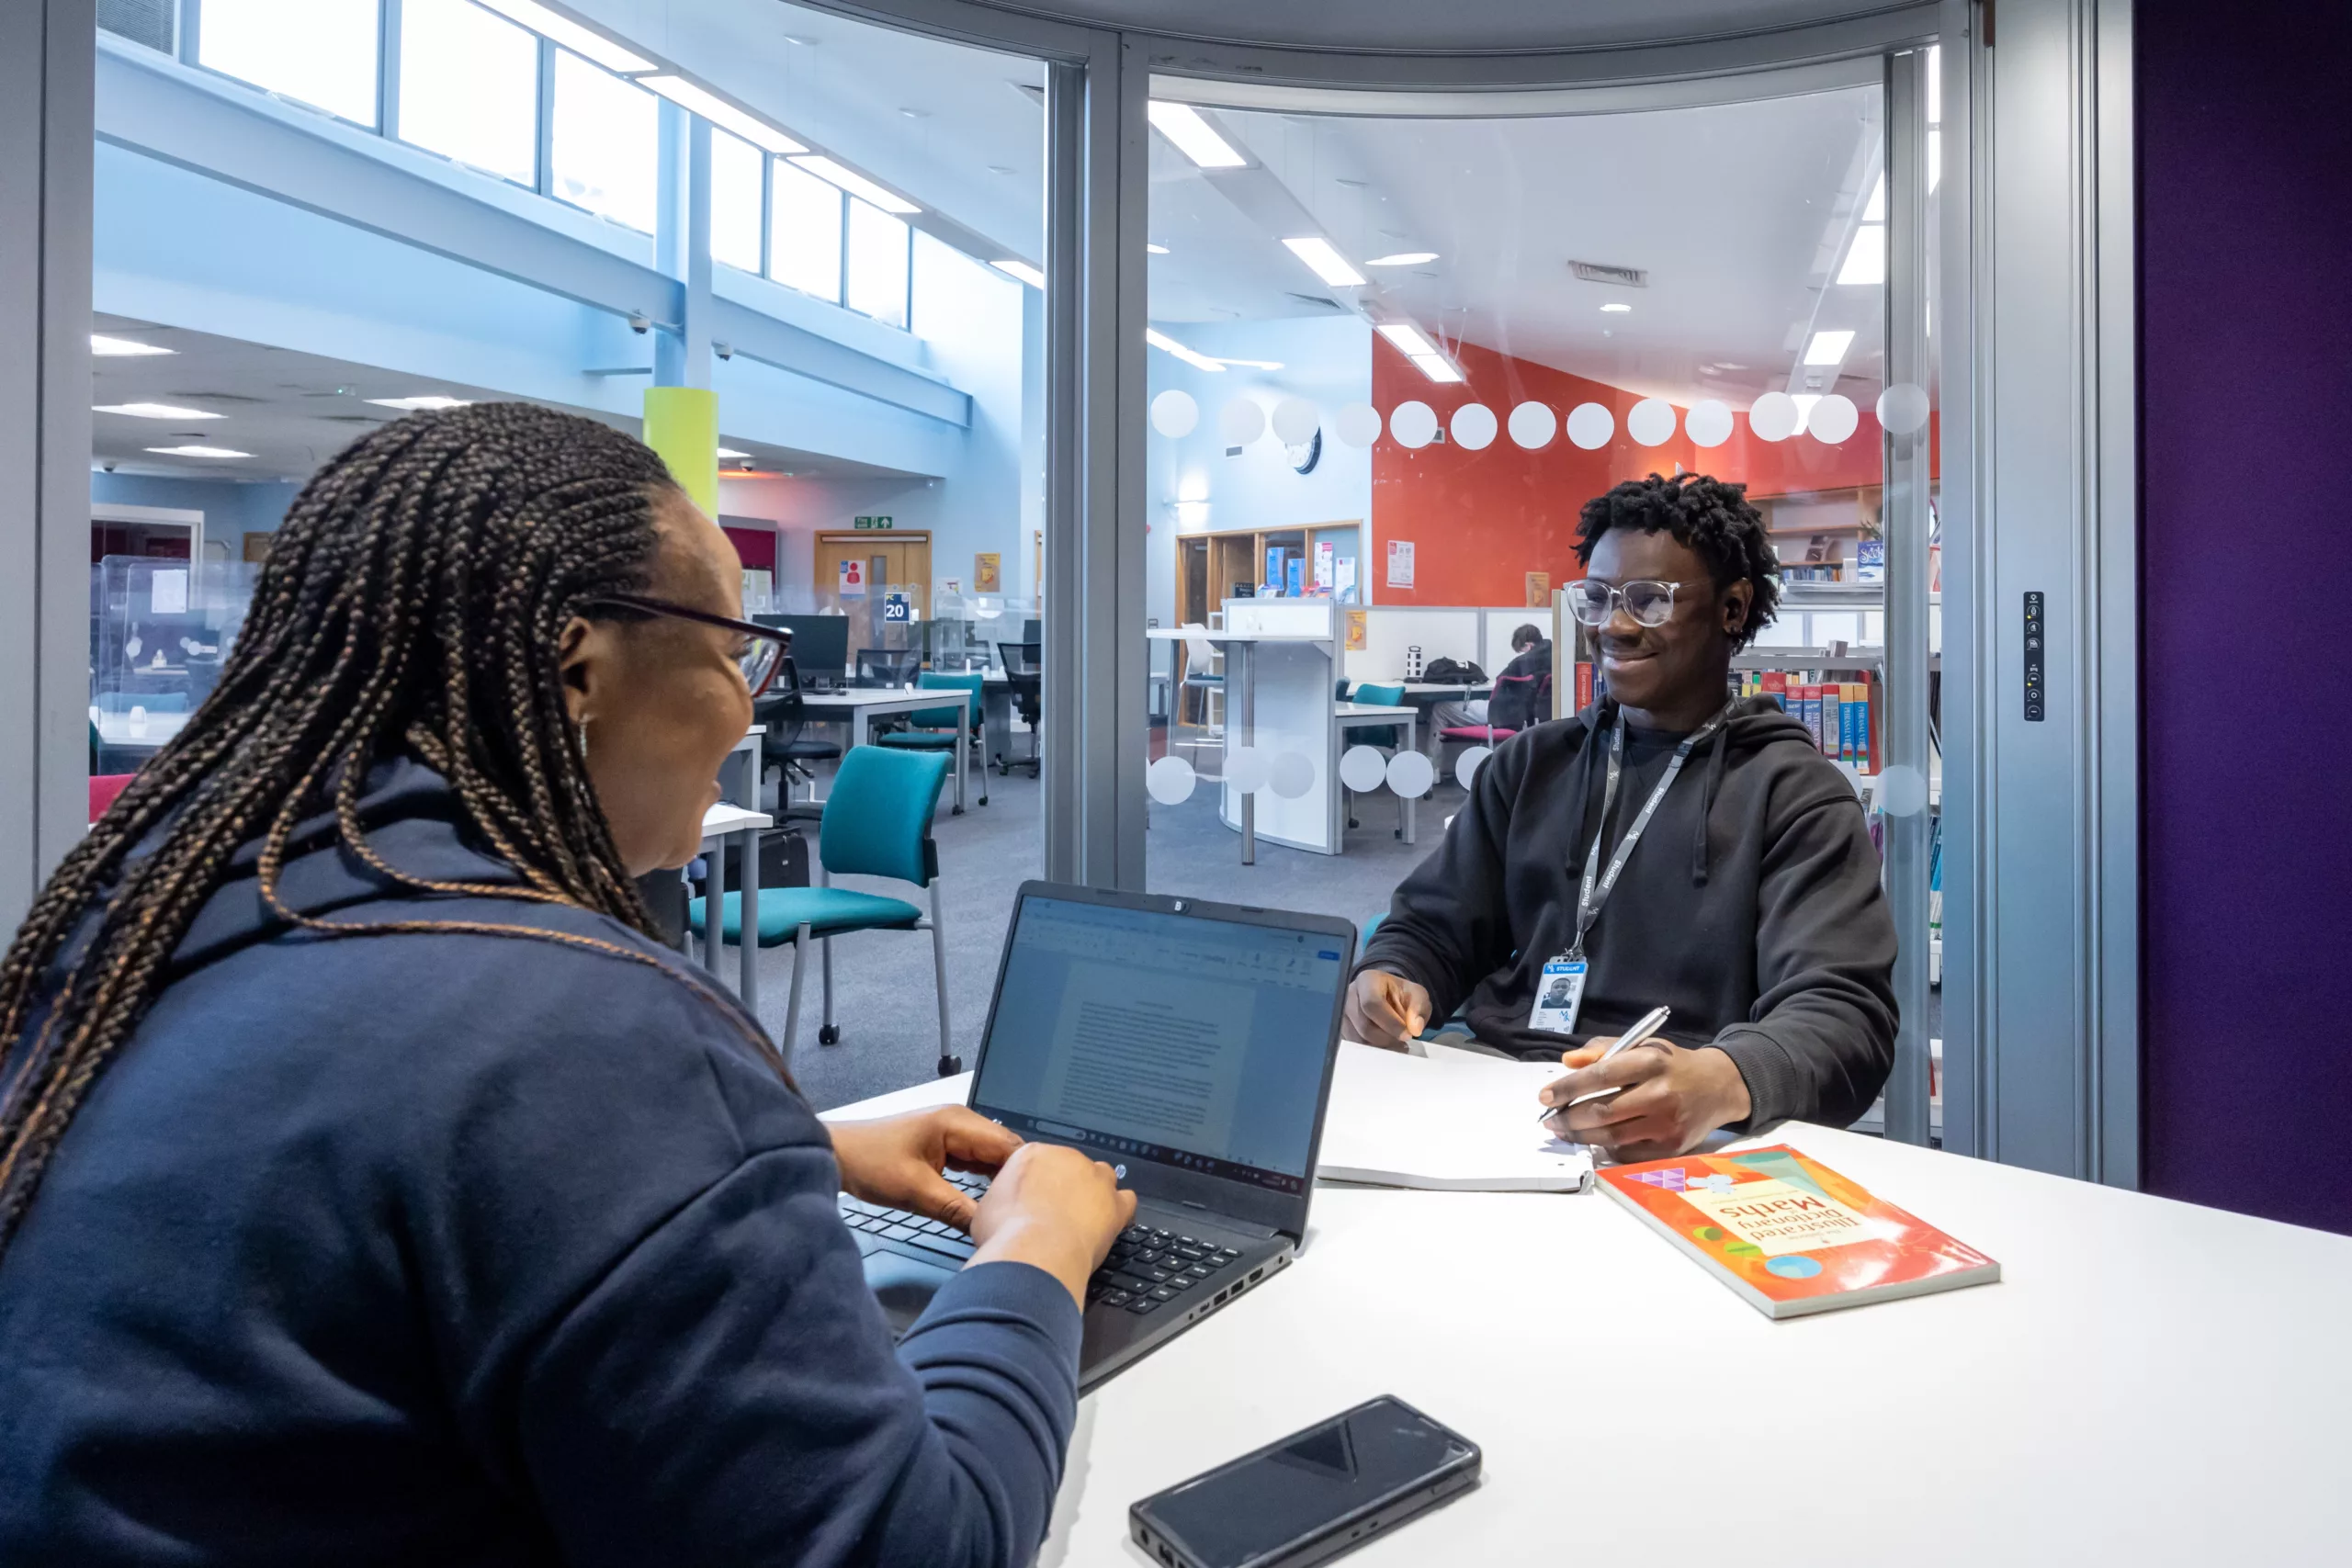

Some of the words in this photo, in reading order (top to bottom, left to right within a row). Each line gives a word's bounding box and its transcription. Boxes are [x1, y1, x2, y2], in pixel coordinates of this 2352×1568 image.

[886, 604, 904, 617] 20
[1612, 728, 1622, 751] Student
[1645, 787, 1665, 814] Student
[1602, 859, 1622, 889] Student
[1581, 875, 1593, 907] Student
[1718, 1196, 1826, 1219] Maths
[1736, 1209, 1843, 1231] Dictionary
[1748, 1217, 1861, 1242] Illustrated
